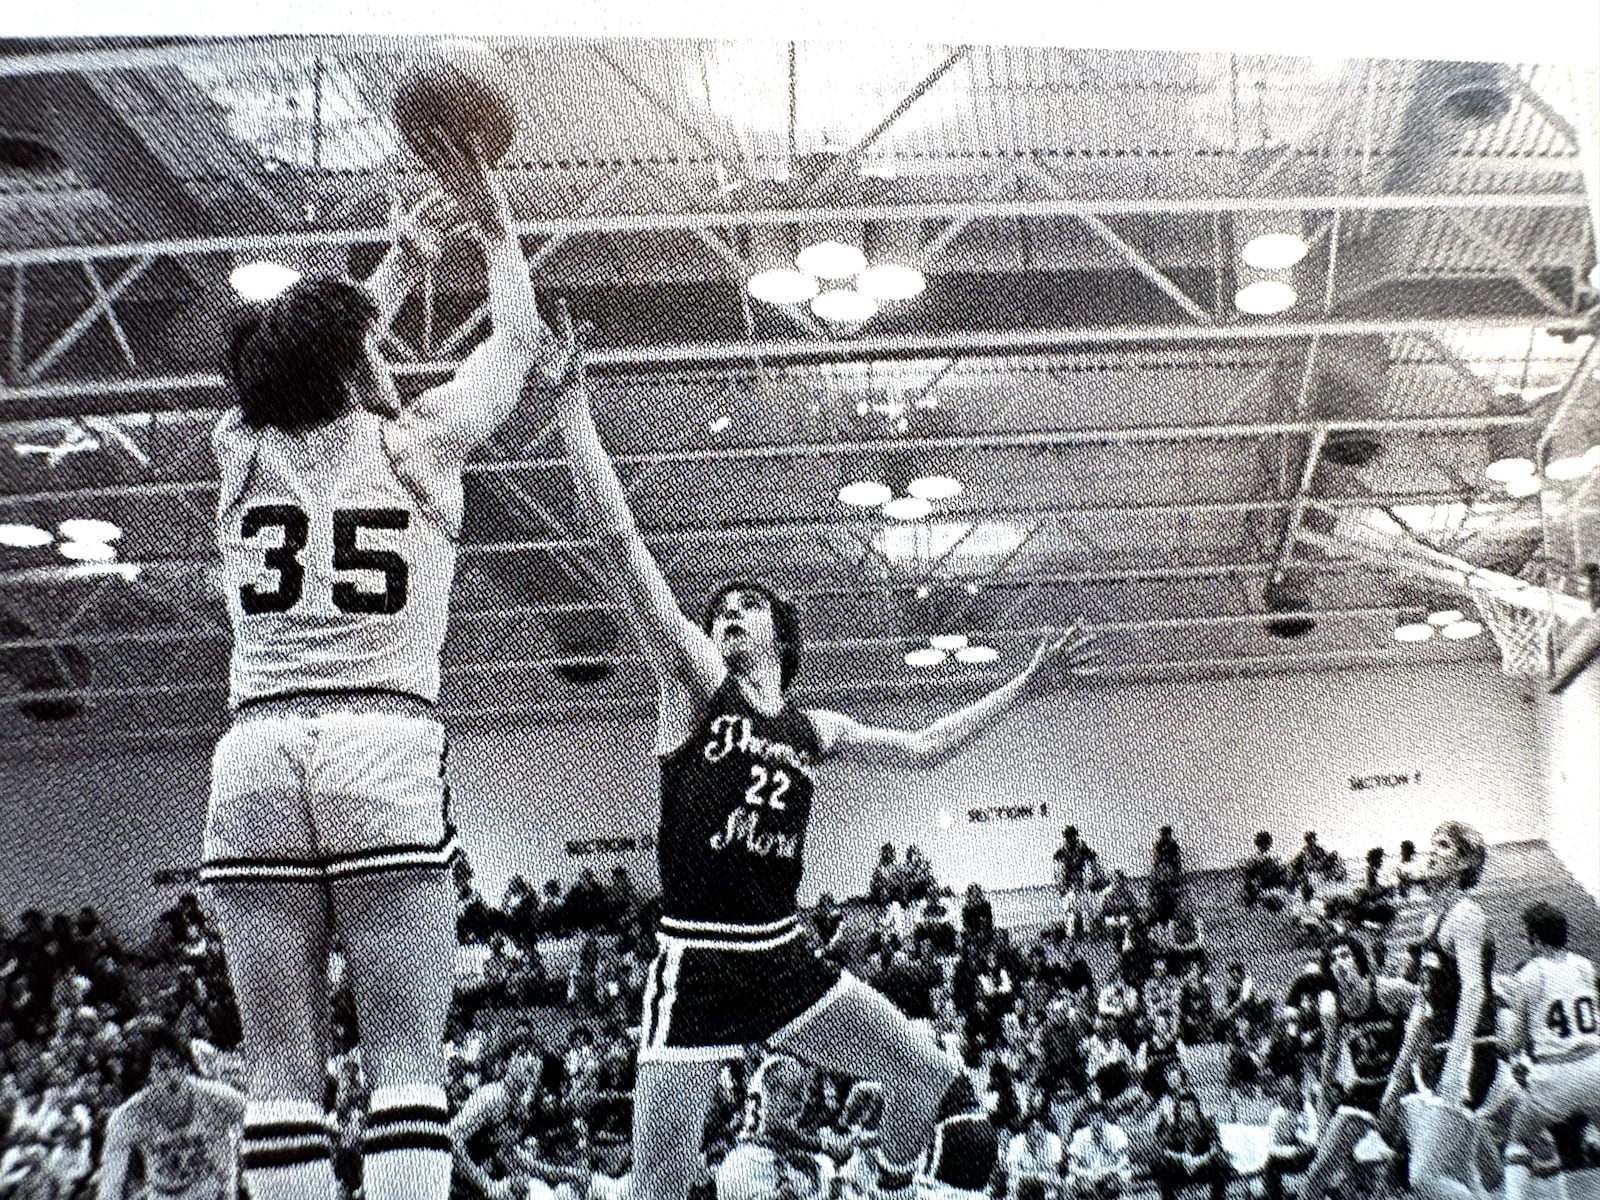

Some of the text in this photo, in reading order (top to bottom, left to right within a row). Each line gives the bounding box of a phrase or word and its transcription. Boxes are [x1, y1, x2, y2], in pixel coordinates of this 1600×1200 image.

[240, 504, 411, 615] 35
[704, 714, 814, 777] Thom
[745, 764, 791, 810] 22
[1545, 995, 1598, 1038] 40
